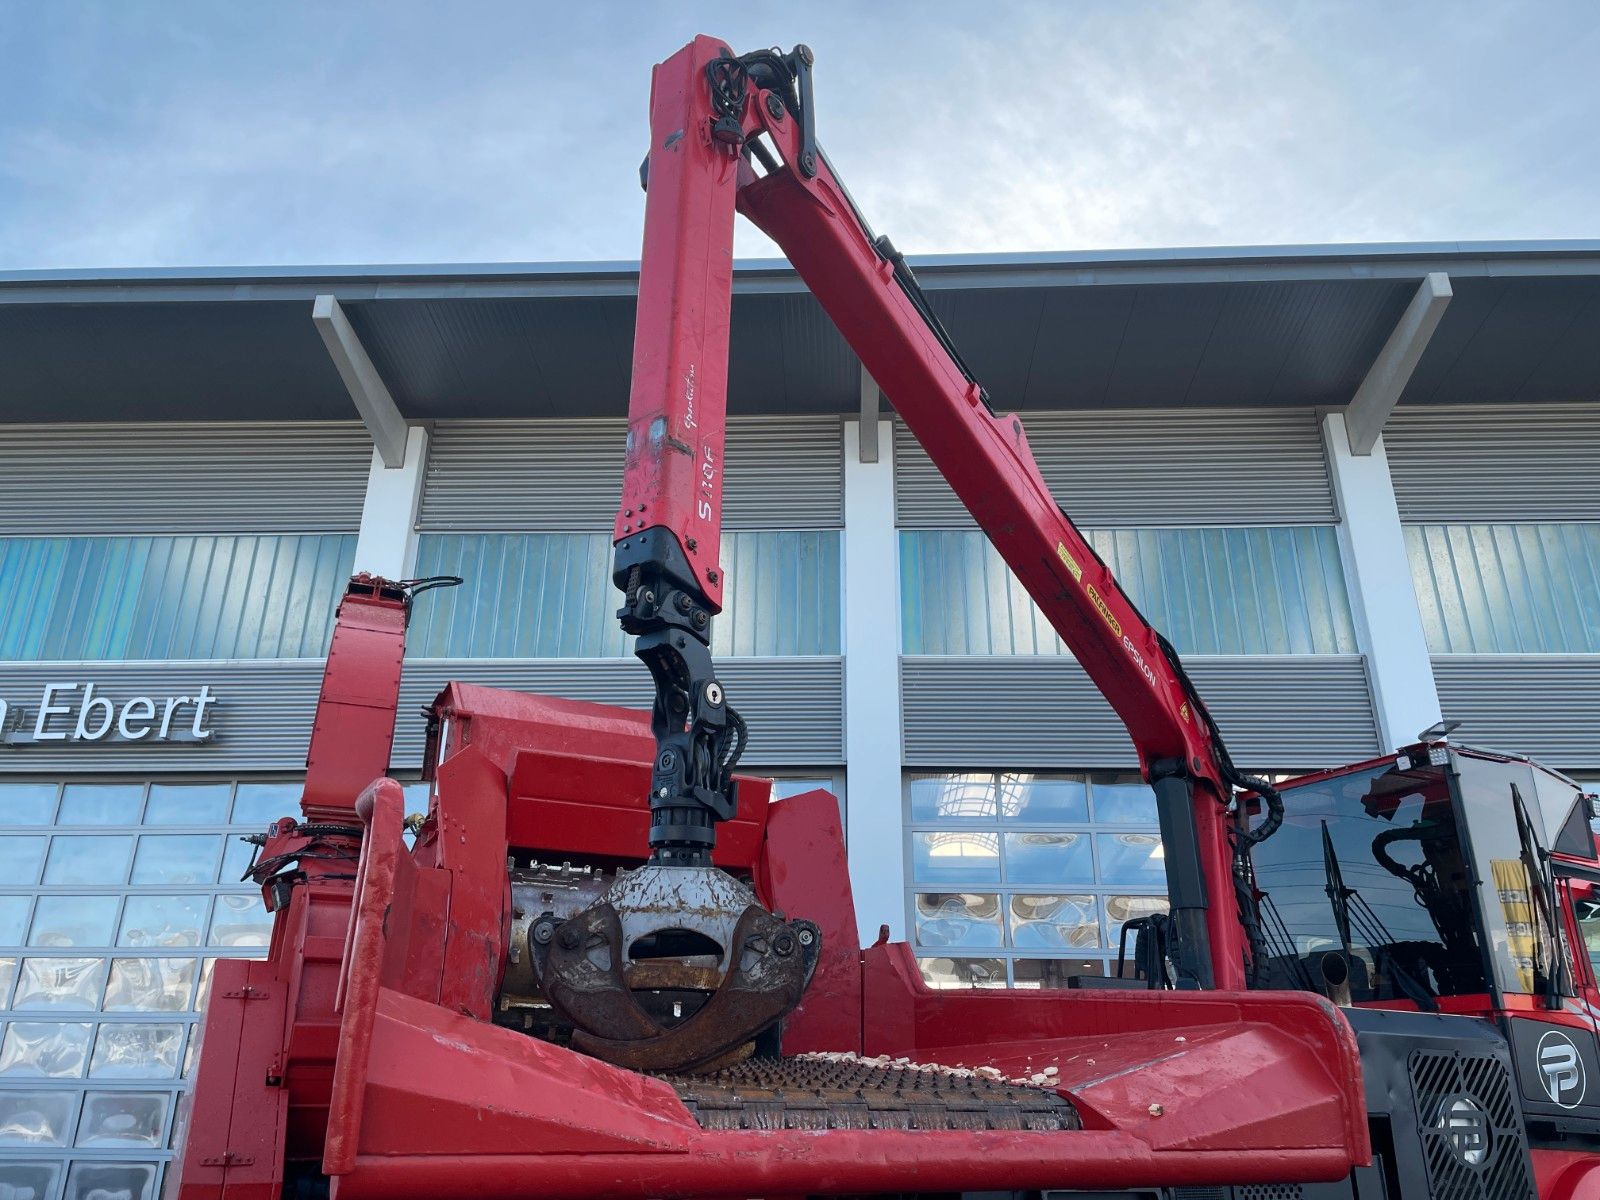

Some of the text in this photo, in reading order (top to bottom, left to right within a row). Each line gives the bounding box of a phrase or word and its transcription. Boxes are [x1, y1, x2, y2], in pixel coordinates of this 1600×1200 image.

[1088, 586, 1156, 687] PALFINGER EPSILON
[33, 682, 216, 741] Ebert
